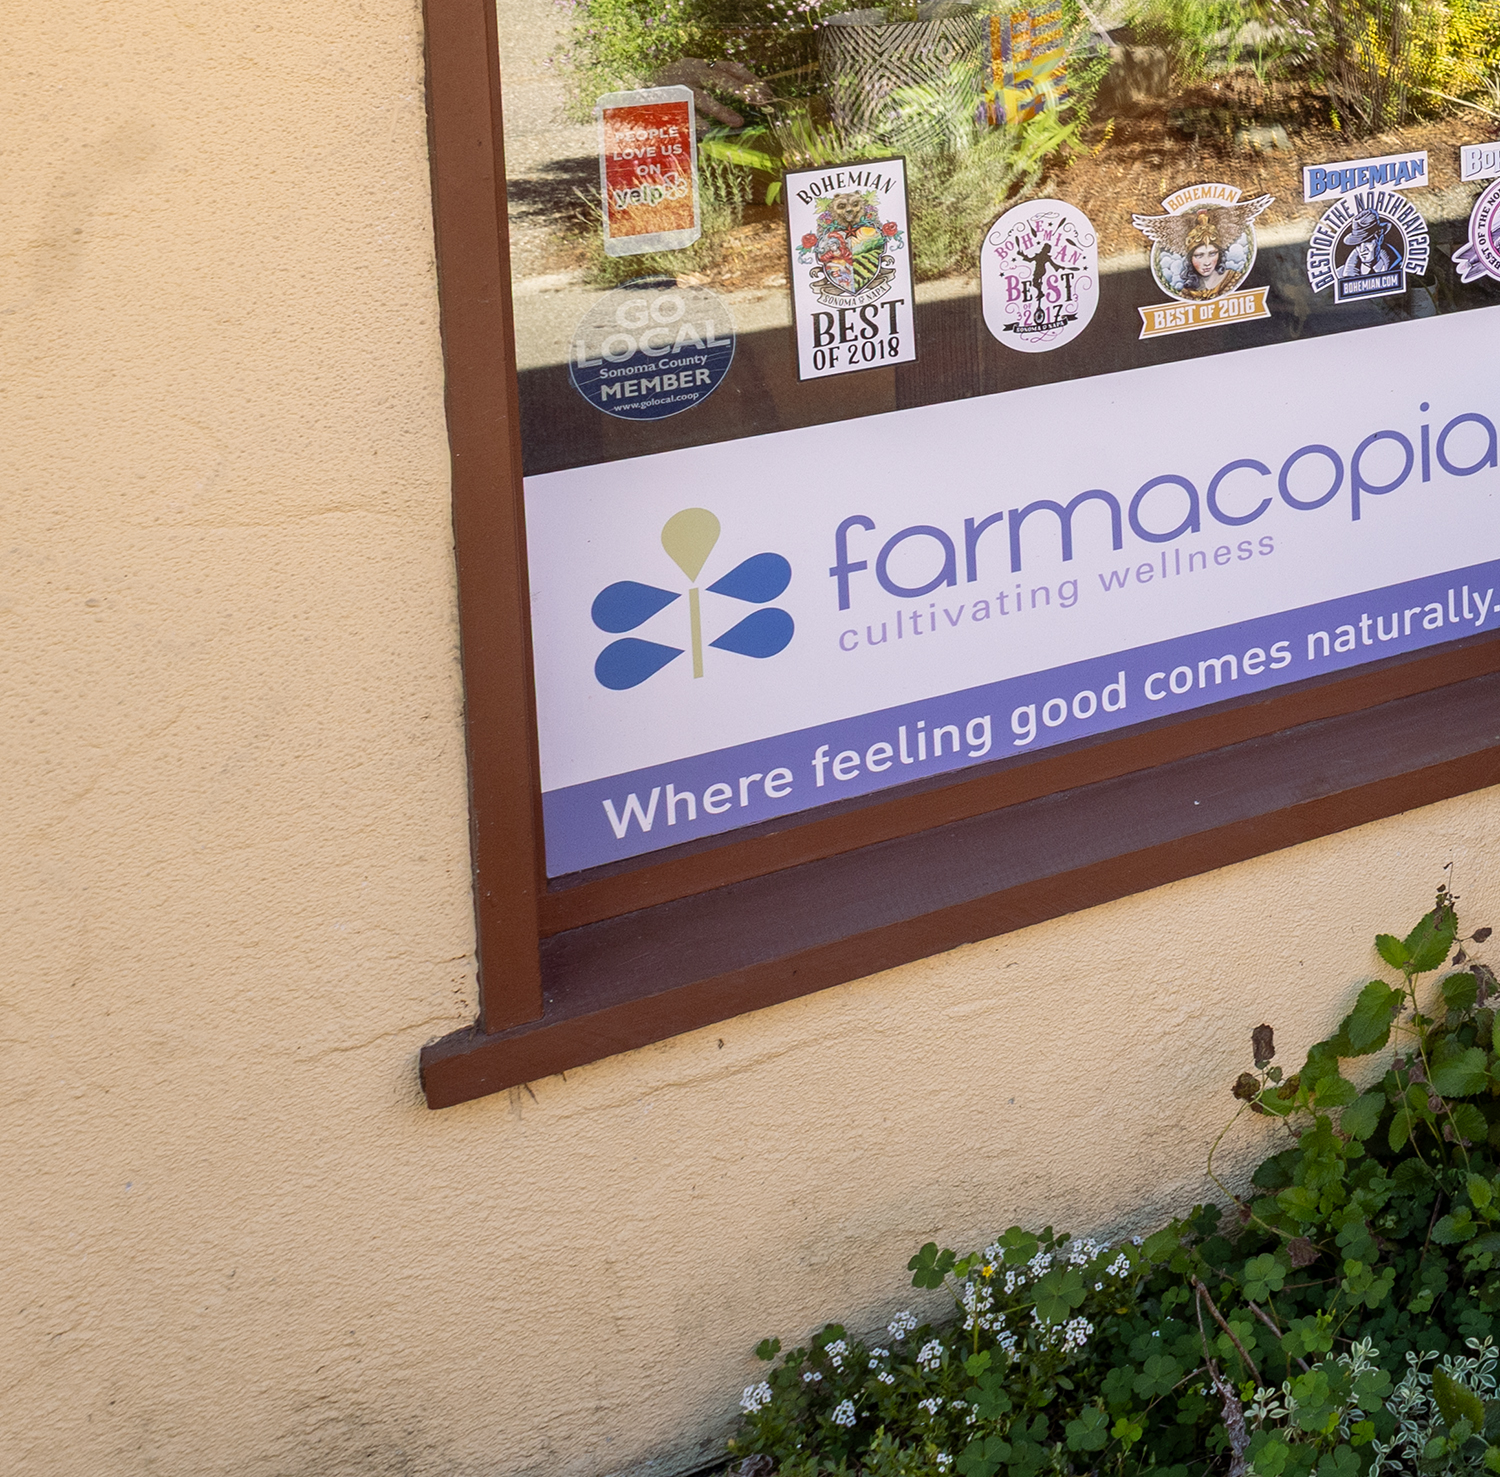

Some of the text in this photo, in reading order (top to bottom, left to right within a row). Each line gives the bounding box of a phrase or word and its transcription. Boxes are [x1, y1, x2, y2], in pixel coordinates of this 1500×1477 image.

[614, 126, 679, 142] PEOPLE
[613, 144, 683, 161] LOVE US
[636, 163, 661, 176] ON
[1308, 158, 1425, 199] BOHEMIAN
[613, 183, 664, 210] yelp
[796, 171, 897, 205] BOHEMIAN
[1168, 186, 1238, 212] BOHEMIAN
[1478, 206, 1488, 230] THE
[994, 220, 1082, 266] BOHEMIAN
[1310, 191, 1428, 290] BEST OF THE NORTH BAY 2015
[1478, 231, 1486, 245] OF
[823, 285, 886, 307] SONOMA NAPA
[1005, 273, 1075, 303] BEST
[1344, 275, 1399, 294] BOHEMIAN.COM
[616, 294, 686, 328] GO
[811, 299, 904, 349] BEST
[1024, 304, 1064, 326] 2017
[1154, 295, 1255, 329] BEST OF 2016
[1016, 321, 1064, 333] SONOMA NAPA
[576, 320, 731, 368] LOCAL
[813, 337, 900, 371] OF 2018
[600, 354, 708, 379] Sonoma County
[601, 369, 711, 401] MEMBER
[614, 391, 699, 413] www.golocal.coop
[829, 401, 1499, 611] farmacopia
[838, 534, 1276, 652] cultivating wellness
[602, 764, 794, 841] Where
[811, 715, 993, 789] feeling
[1010, 671, 1127, 748] good
[1144, 640, 1292, 704] comes
